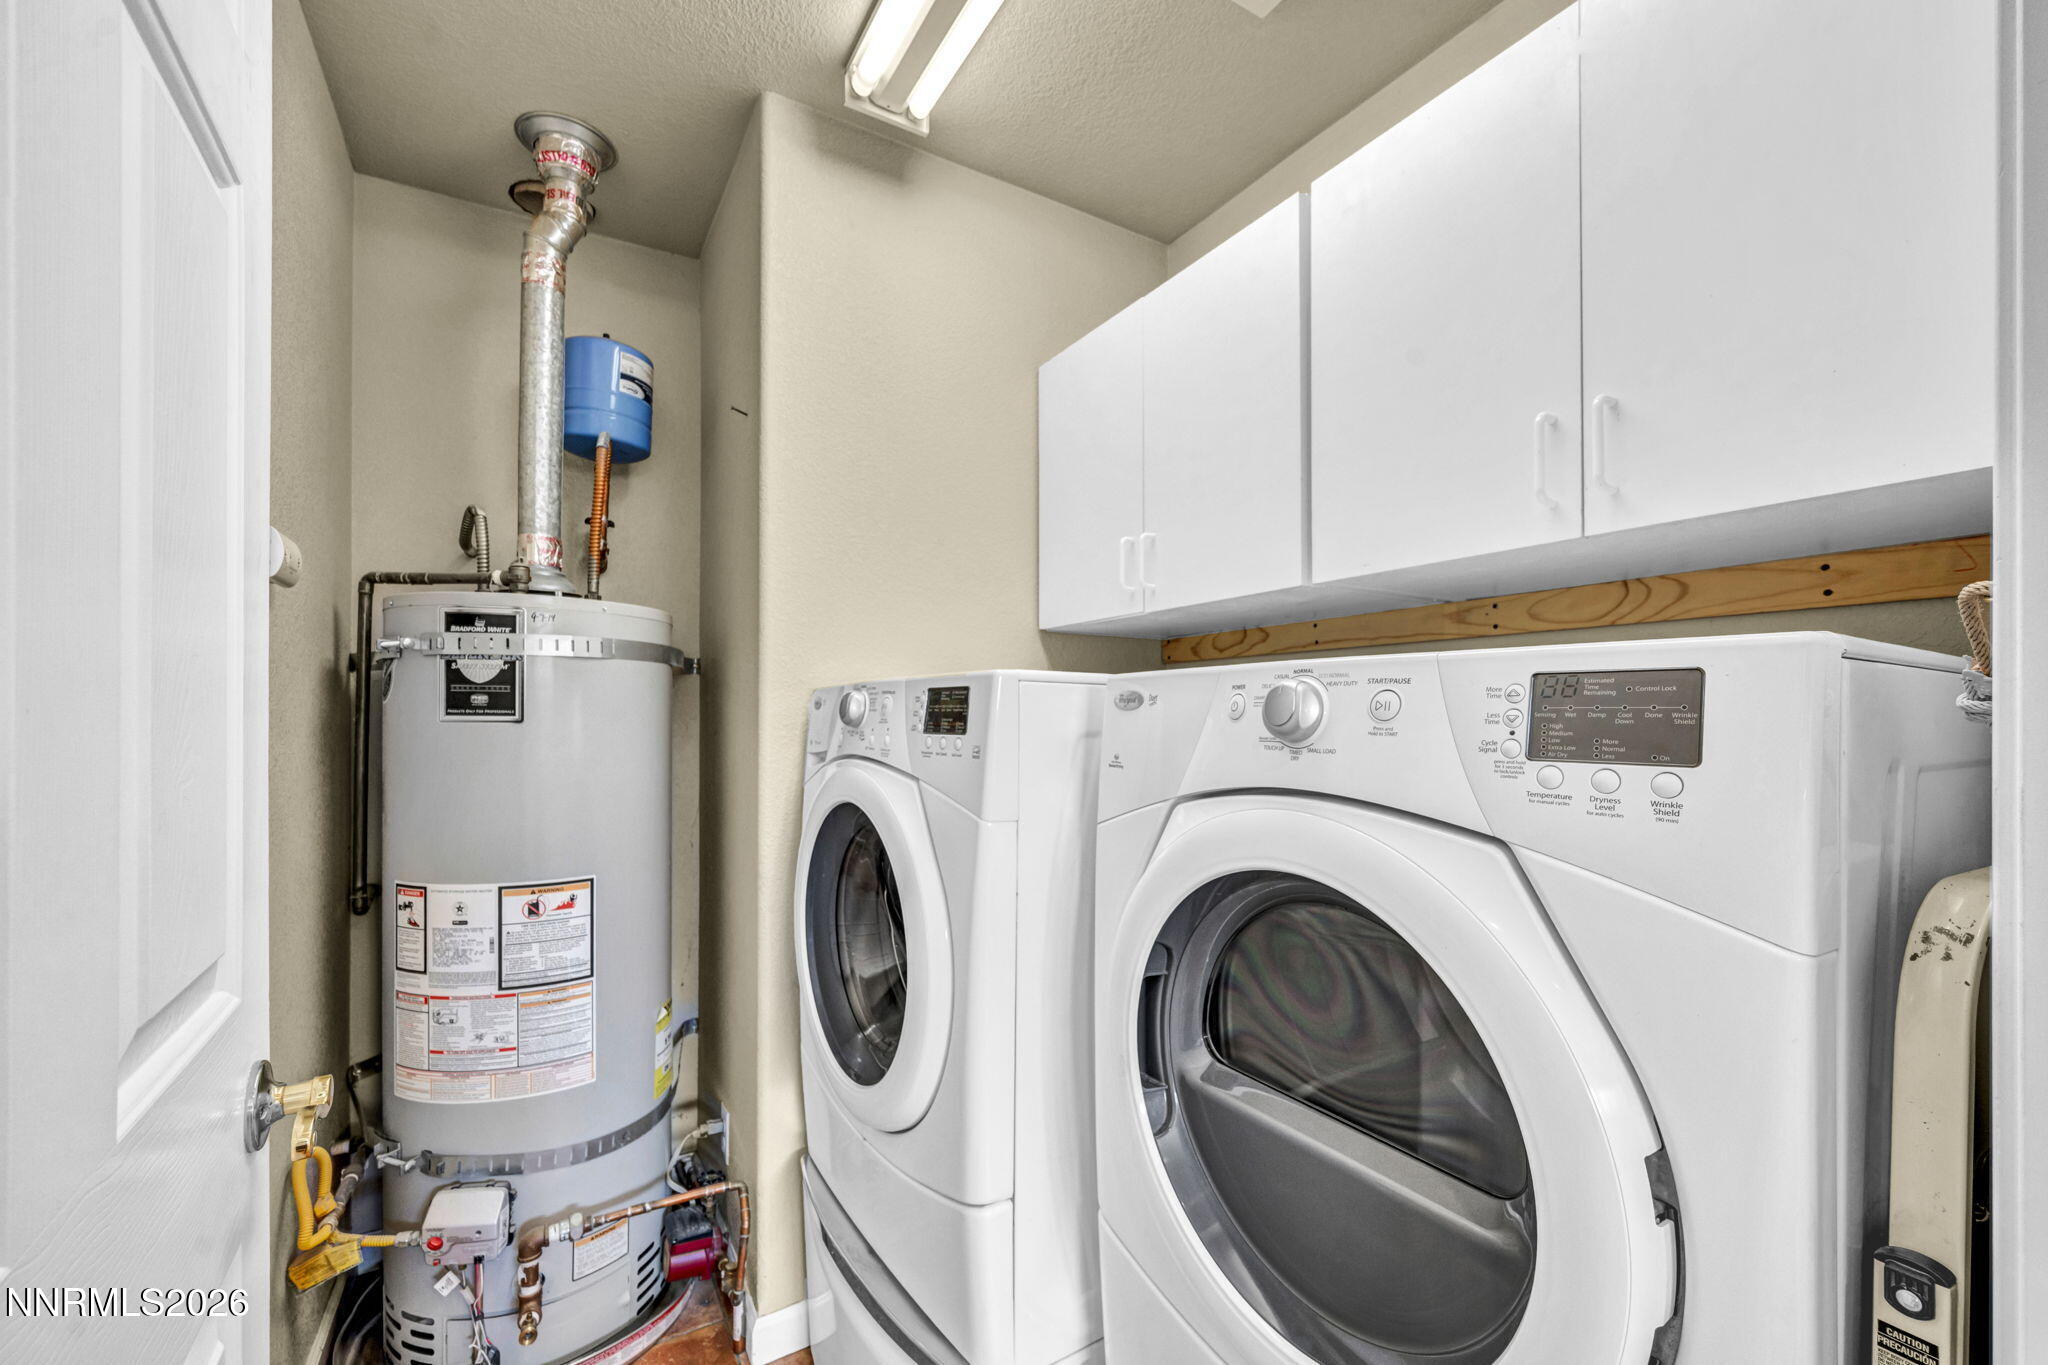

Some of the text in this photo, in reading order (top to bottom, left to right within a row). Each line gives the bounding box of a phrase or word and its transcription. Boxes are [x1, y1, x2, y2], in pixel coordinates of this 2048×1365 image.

[1478, 746, 1498, 754] Signal
[1526, 790, 1573, 800] Temperature
[1589, 795, 1622, 805] Dryness
[1650, 800, 1684, 809] Wrinkle
[1594, 803, 1616, 812] Level
[1653, 808, 1680, 817] Shield
[1886, 1327, 1930, 1353] CAUTION
[1877, 1335, 1937, 1365] PRECAUCIÓN
